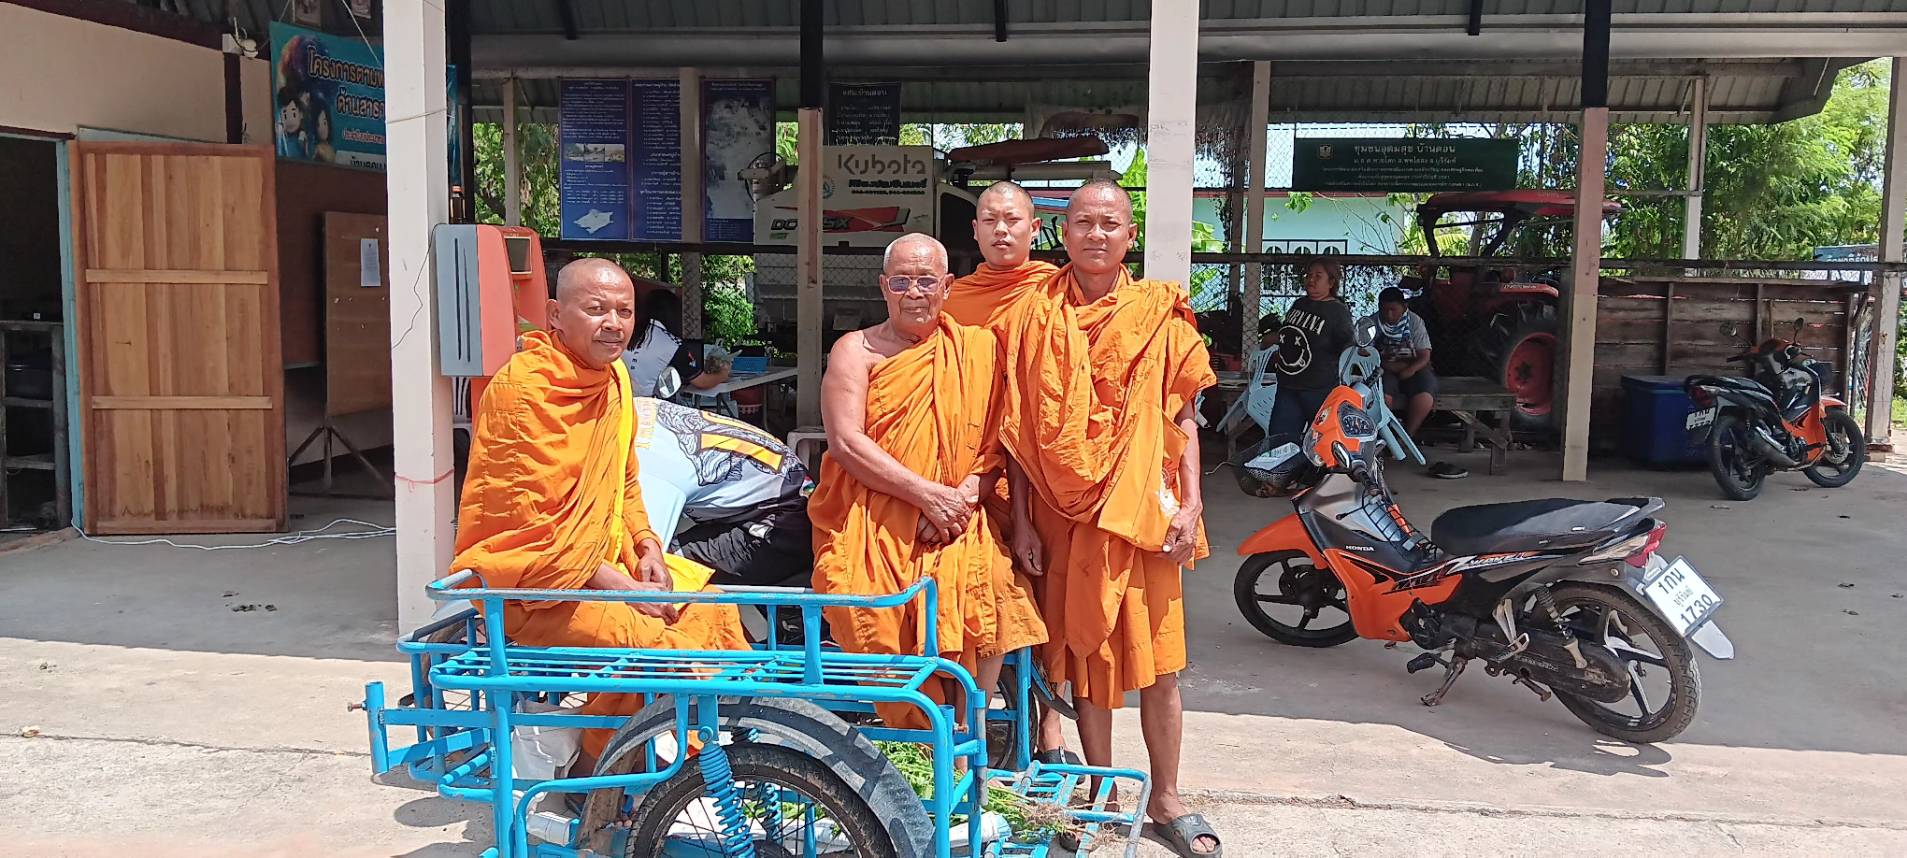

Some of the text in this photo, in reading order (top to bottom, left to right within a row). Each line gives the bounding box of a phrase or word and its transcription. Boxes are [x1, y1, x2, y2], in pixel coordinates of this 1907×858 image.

[838, 154, 926, 175] Kubota
[1658, 567, 1686, 594] 1กน
[1681, 594, 1713, 625] 1730
